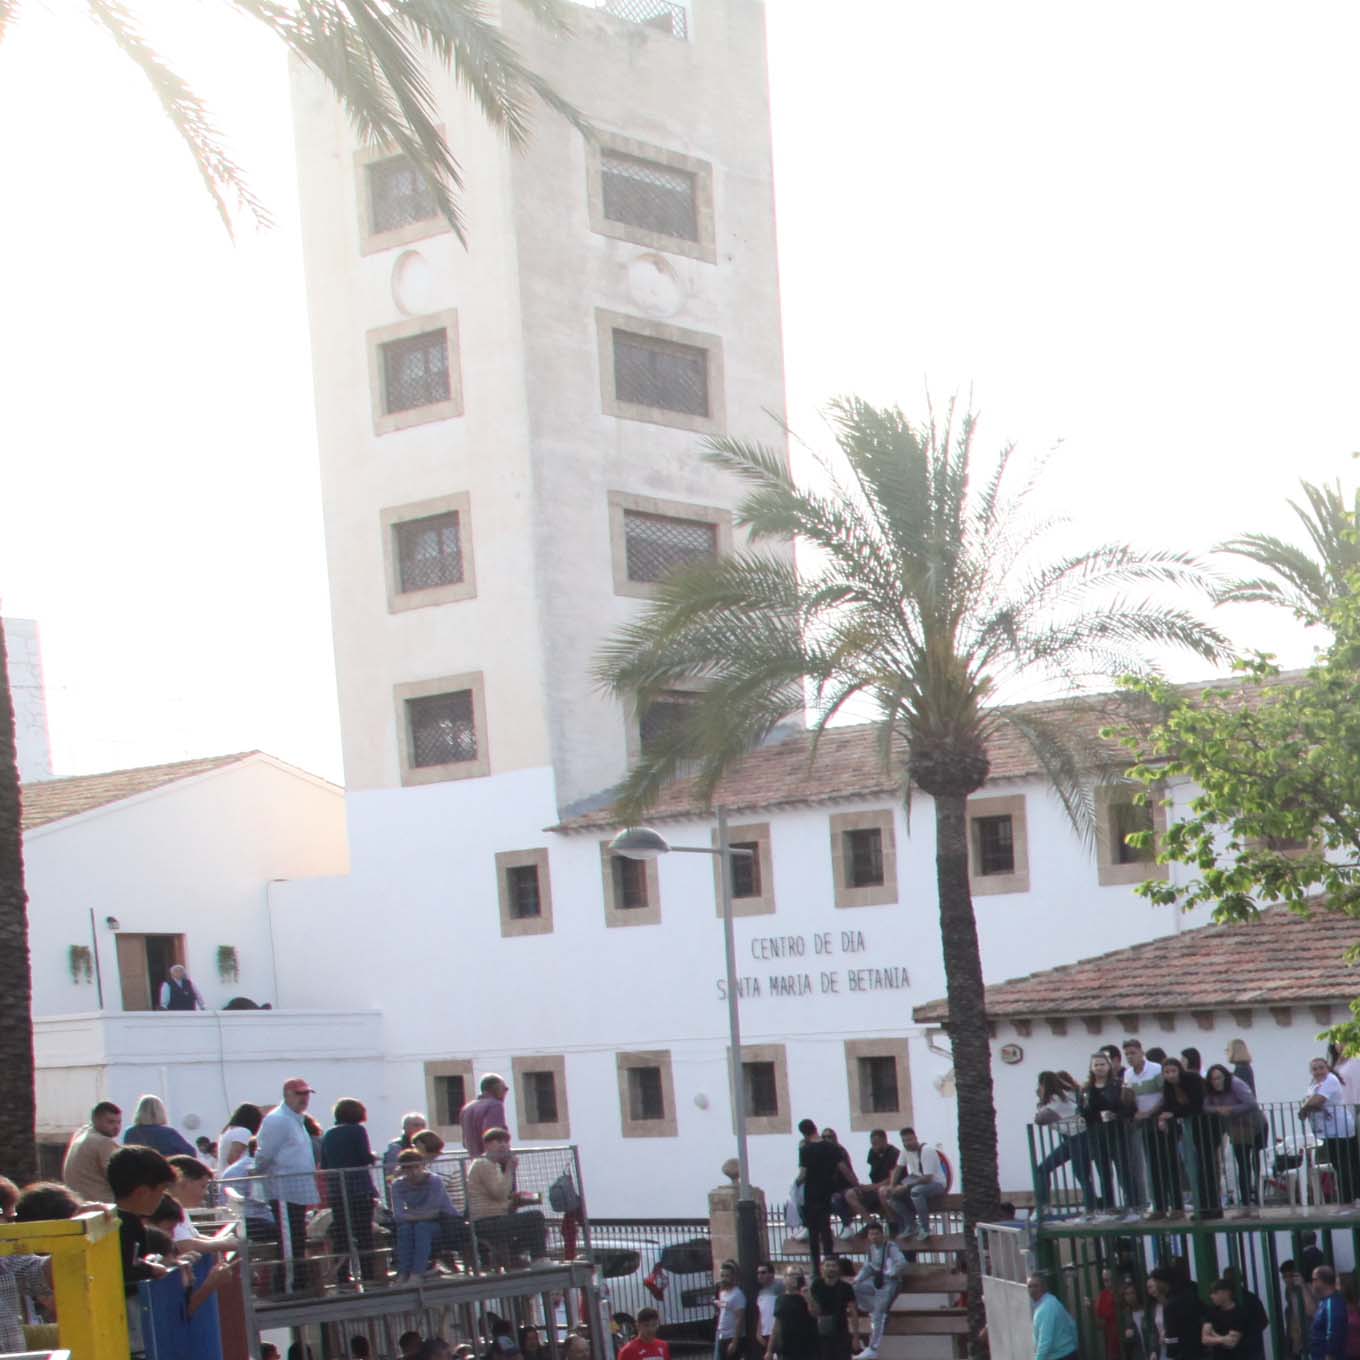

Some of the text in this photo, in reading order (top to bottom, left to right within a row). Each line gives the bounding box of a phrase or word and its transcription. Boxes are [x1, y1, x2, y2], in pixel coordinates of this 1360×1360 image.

[751, 930, 867, 960] CENTRO DE DIA
[716, 966, 912, 1001] SNTA MARIA DE BETANIA
